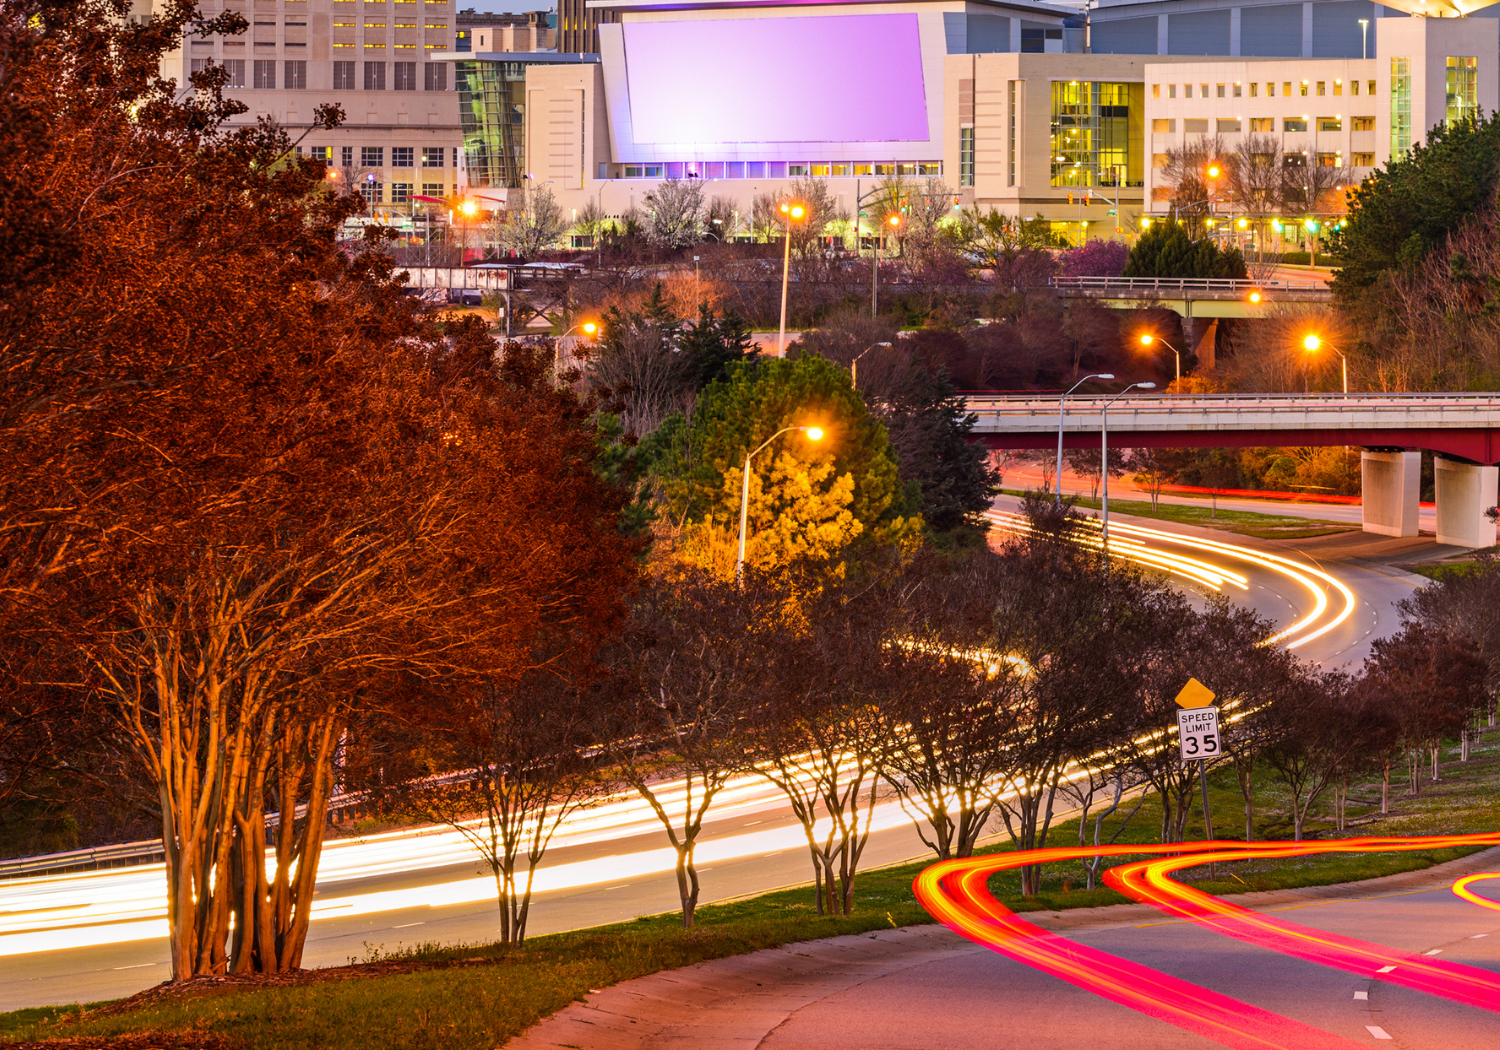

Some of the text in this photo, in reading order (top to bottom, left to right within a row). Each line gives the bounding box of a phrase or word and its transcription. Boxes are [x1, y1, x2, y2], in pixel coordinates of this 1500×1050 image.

[1181, 712, 1215, 723] SPEED
[1185, 723, 1212, 733] LIMIT
[1185, 734, 1217, 755] 35
